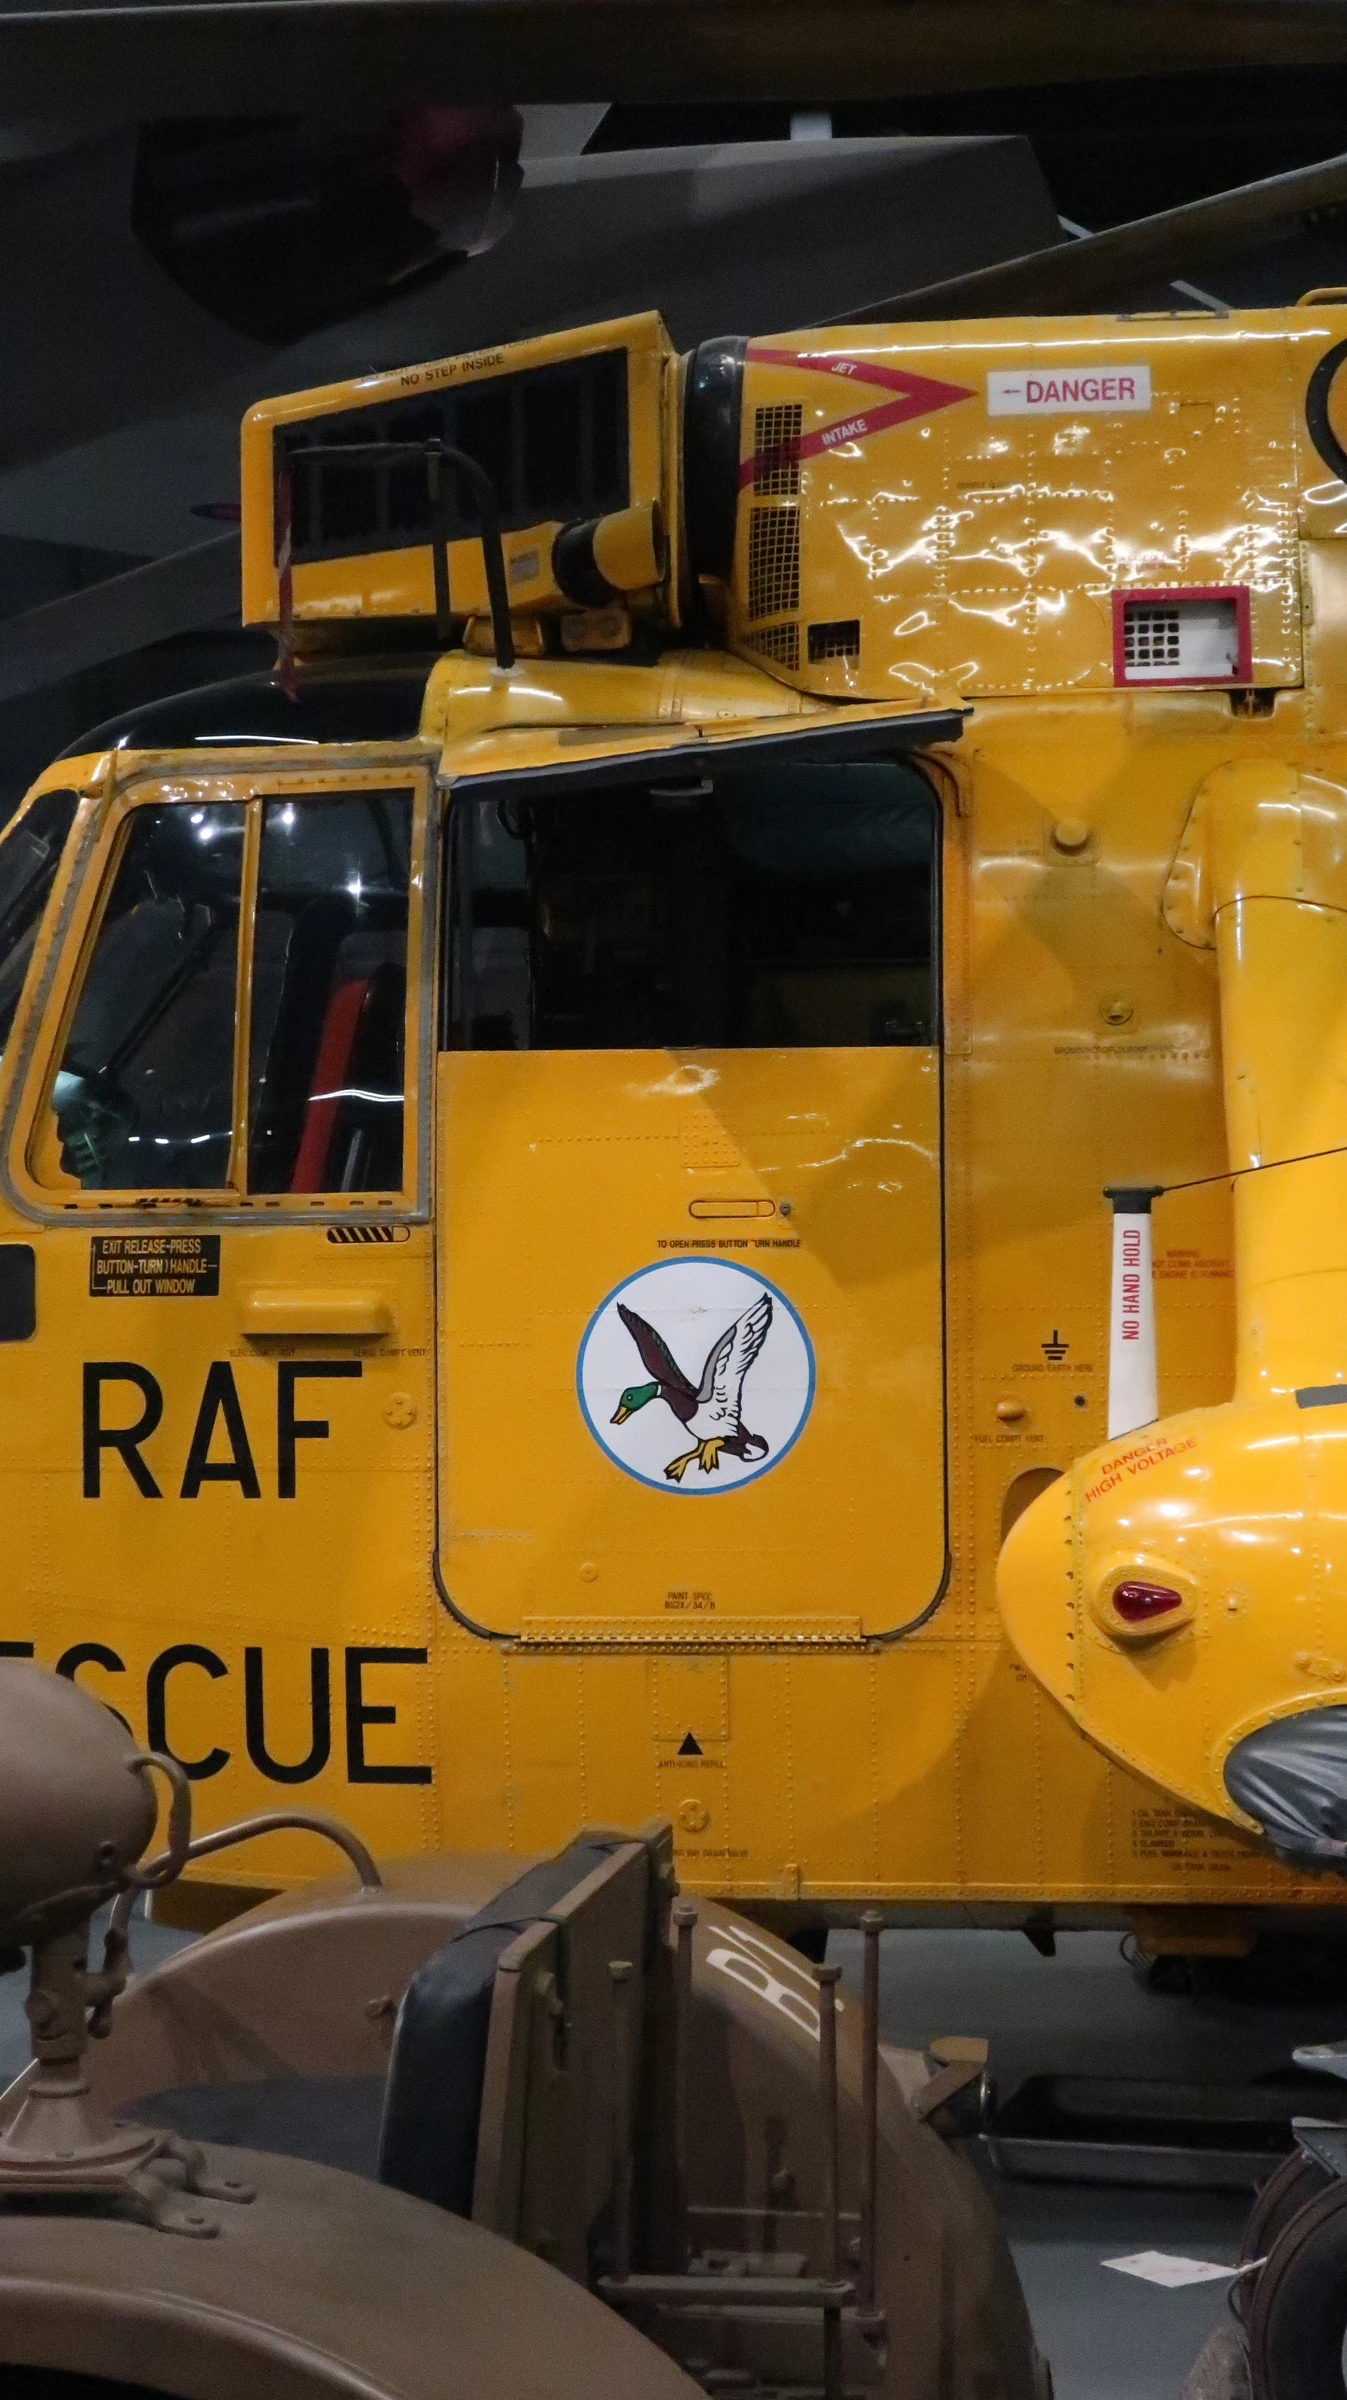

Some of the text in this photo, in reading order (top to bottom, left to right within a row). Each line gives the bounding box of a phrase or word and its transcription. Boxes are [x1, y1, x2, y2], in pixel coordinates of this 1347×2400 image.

[401, 353, 505, 386] NO STEP INSIDE
[831, 362, 857, 375] JET
[1026, 377, 1135, 404] DANGER
[821, 418, 868, 446] INTAKE
[102, 1240, 122, 1255] EXIT
[657, 1239, 667, 1248] TO
[670, 1239, 689, 1248] OPEN
[692, 1239, 716, 1248] PRESS
[718, 1239, 748, 1249] BUTTON
[773, 1239, 801, 1248] HANDLE
[169, 1258, 208, 1274] HANDLE
[106, 1278, 196, 1294] PULL OUT WINDOW
[1122, 1229, 1141, 1341] NO HAND HOLD
[407, 1348, 427, 1357] VENT
[1013, 1364, 1044, 1372] GROUND
[82, 1360, 363, 1500] RAF
[1085, 1437, 1199, 1503] HIGH VOLTAGE
[0, 1641, 433, 1784] SCUE
